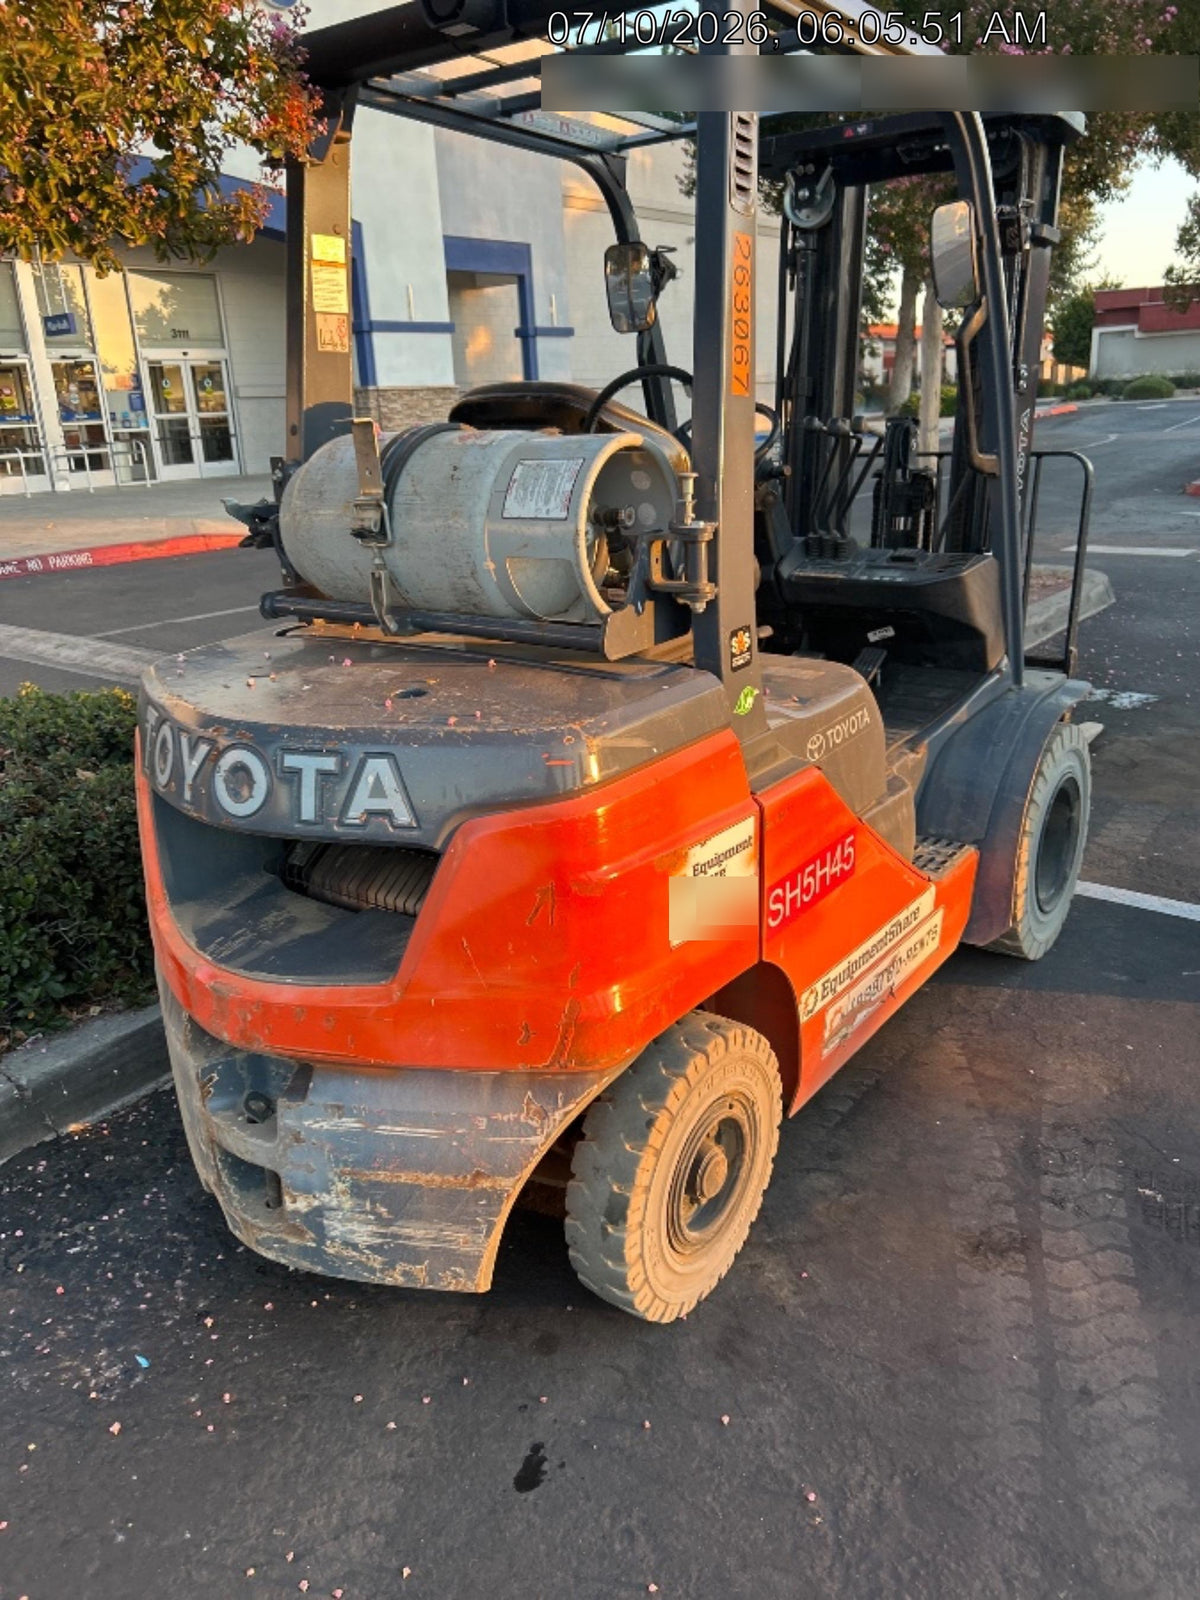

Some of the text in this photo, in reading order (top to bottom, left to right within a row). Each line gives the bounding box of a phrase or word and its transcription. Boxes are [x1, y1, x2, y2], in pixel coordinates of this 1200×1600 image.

[733, 236, 750, 391] 263067
[47, 552, 93, 568] PARKING
[144, 704, 416, 827] TOYOTA
[825, 707, 871, 749] TOYOTA
[692, 836, 753, 877] Equipment
[767, 834, 855, 928] SH5H45
[820, 906, 921, 1002] EquipmentShare
